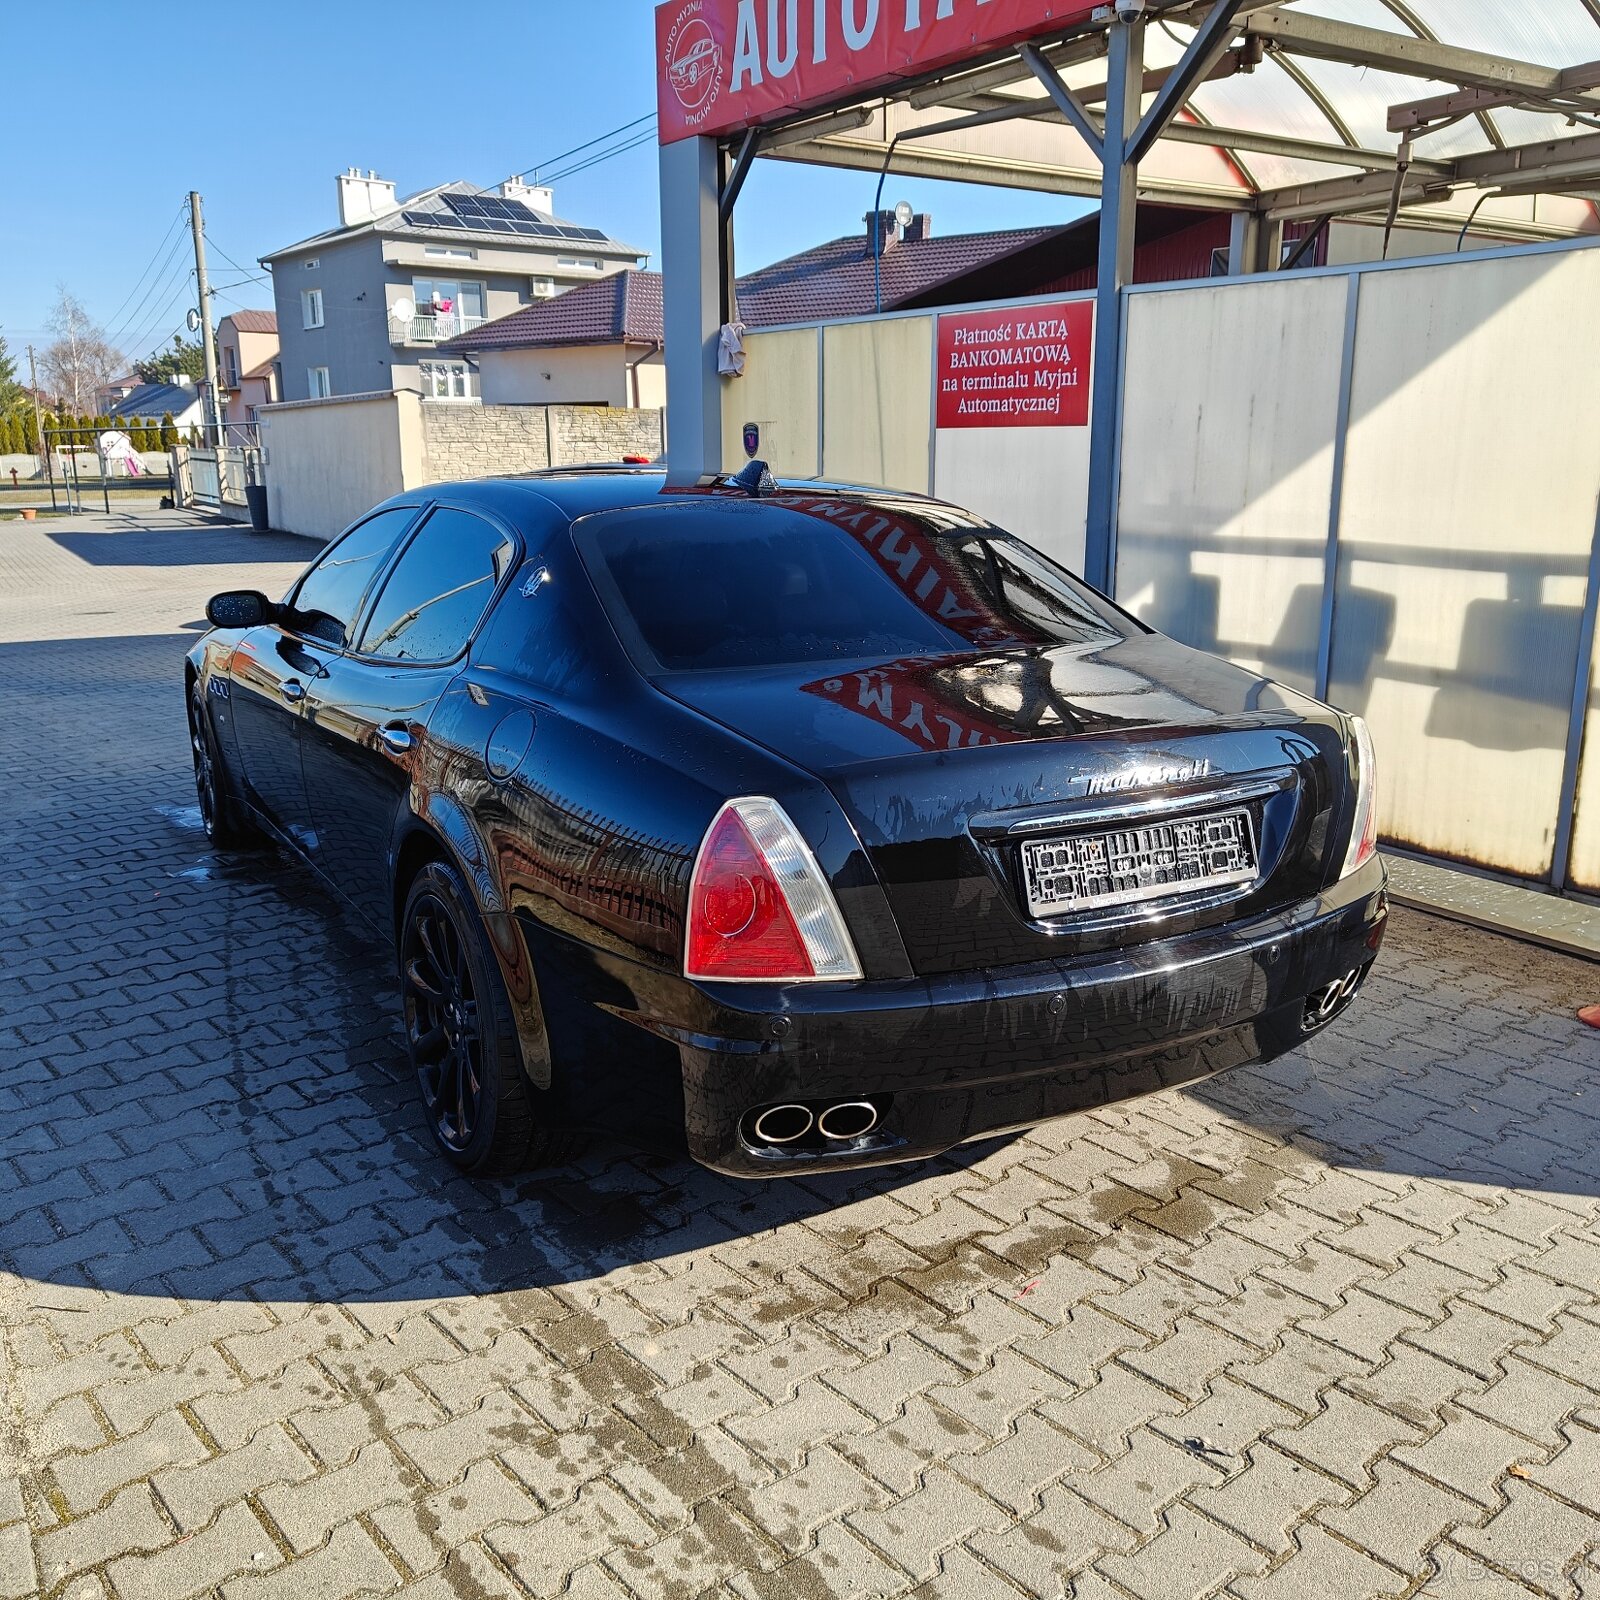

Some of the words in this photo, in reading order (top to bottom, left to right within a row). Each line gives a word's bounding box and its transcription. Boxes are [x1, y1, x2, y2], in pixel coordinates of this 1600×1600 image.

[664, 25, 678, 63] AUTO
[676, 0, 704, 27] MYJNIA
[729, 0, 879, 93] AUTO
[710, 65, 723, 103] AUTO
[954, 323, 1011, 346] Płatność
[1015, 319, 1068, 341] KARTĄ
[950, 344, 1071, 369] BANKOMATOWĄ
[942, 378, 957, 392] na
[962, 370, 1029, 391] terminalu
[1033, 367, 1078, 390] Myjni
[957, 393, 1060, 415] Automatycznej
